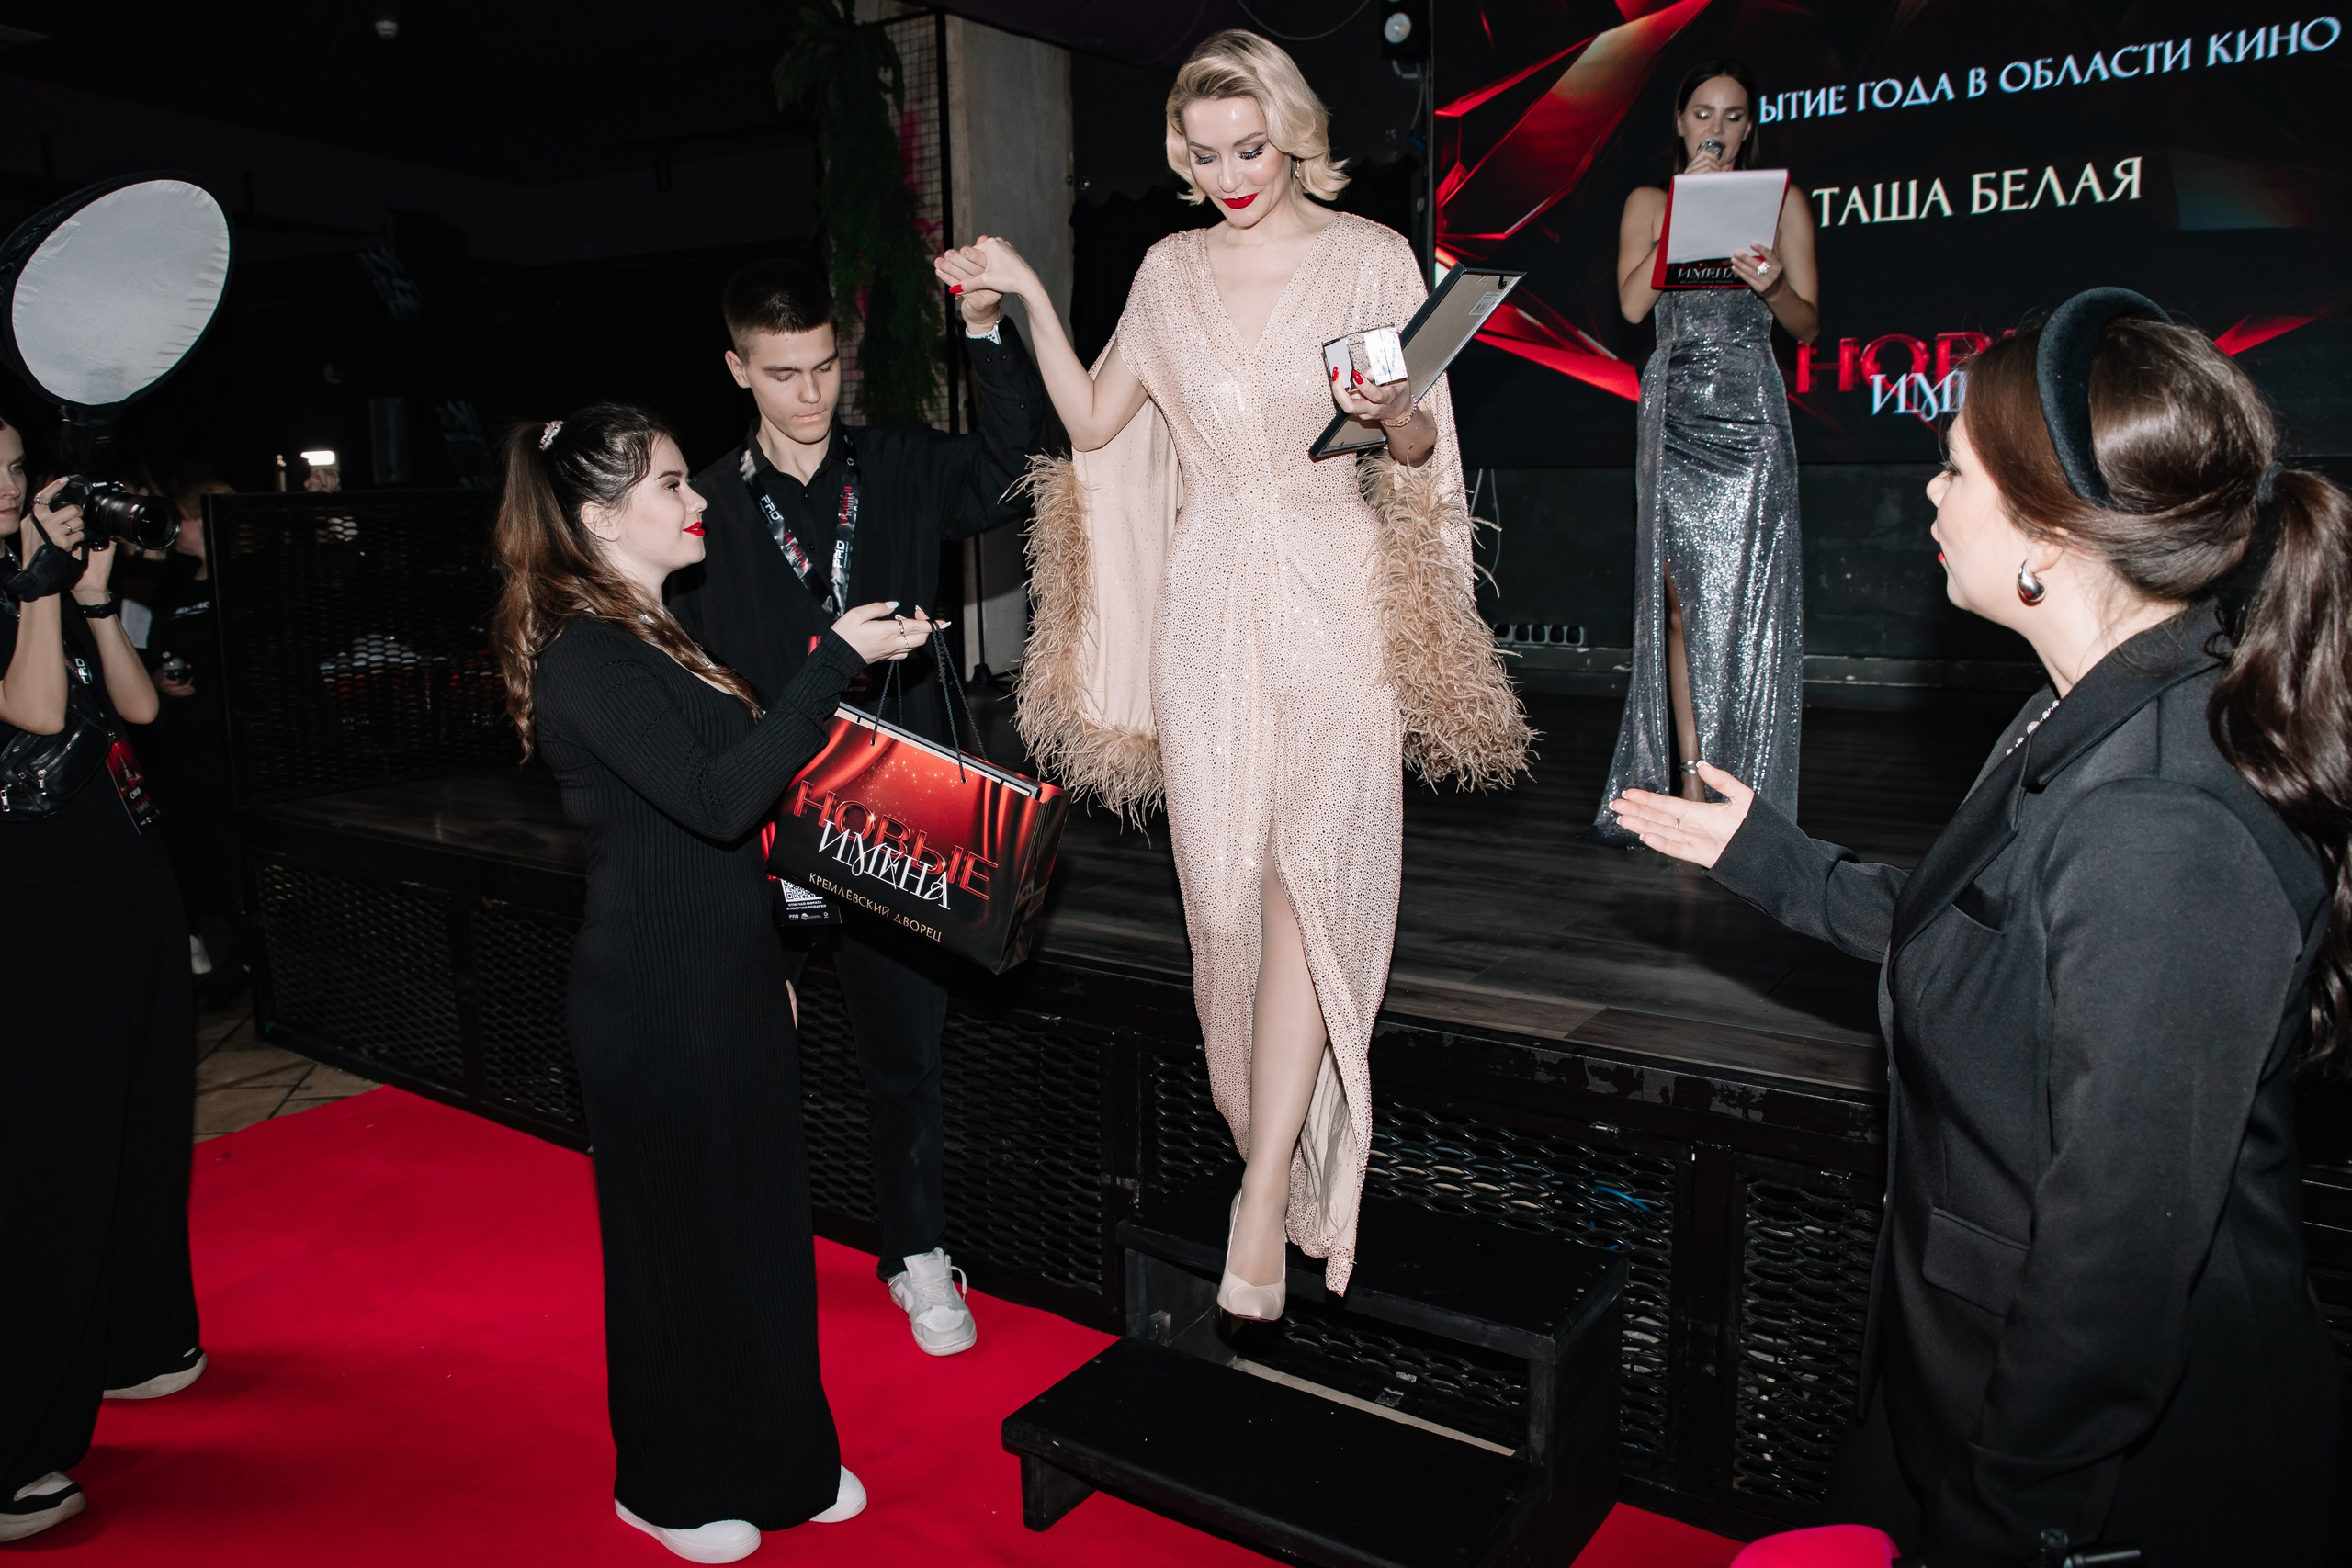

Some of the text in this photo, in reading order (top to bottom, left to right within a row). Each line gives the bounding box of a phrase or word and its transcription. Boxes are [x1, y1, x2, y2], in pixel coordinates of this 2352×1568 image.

[1758, 16, 2342, 125] ЫТИЕ ГОДА В ОБЛАСТИ КИНО
[1810, 156, 2143, 228] ТАША БЕЛАЯ
[1796, 328, 2017, 393] НОВ
[793, 779, 998, 900] НОВЫЕ
[808, 872, 942, 942] КРЕМЛЁВСКИЙ ДВОРЕЦ
